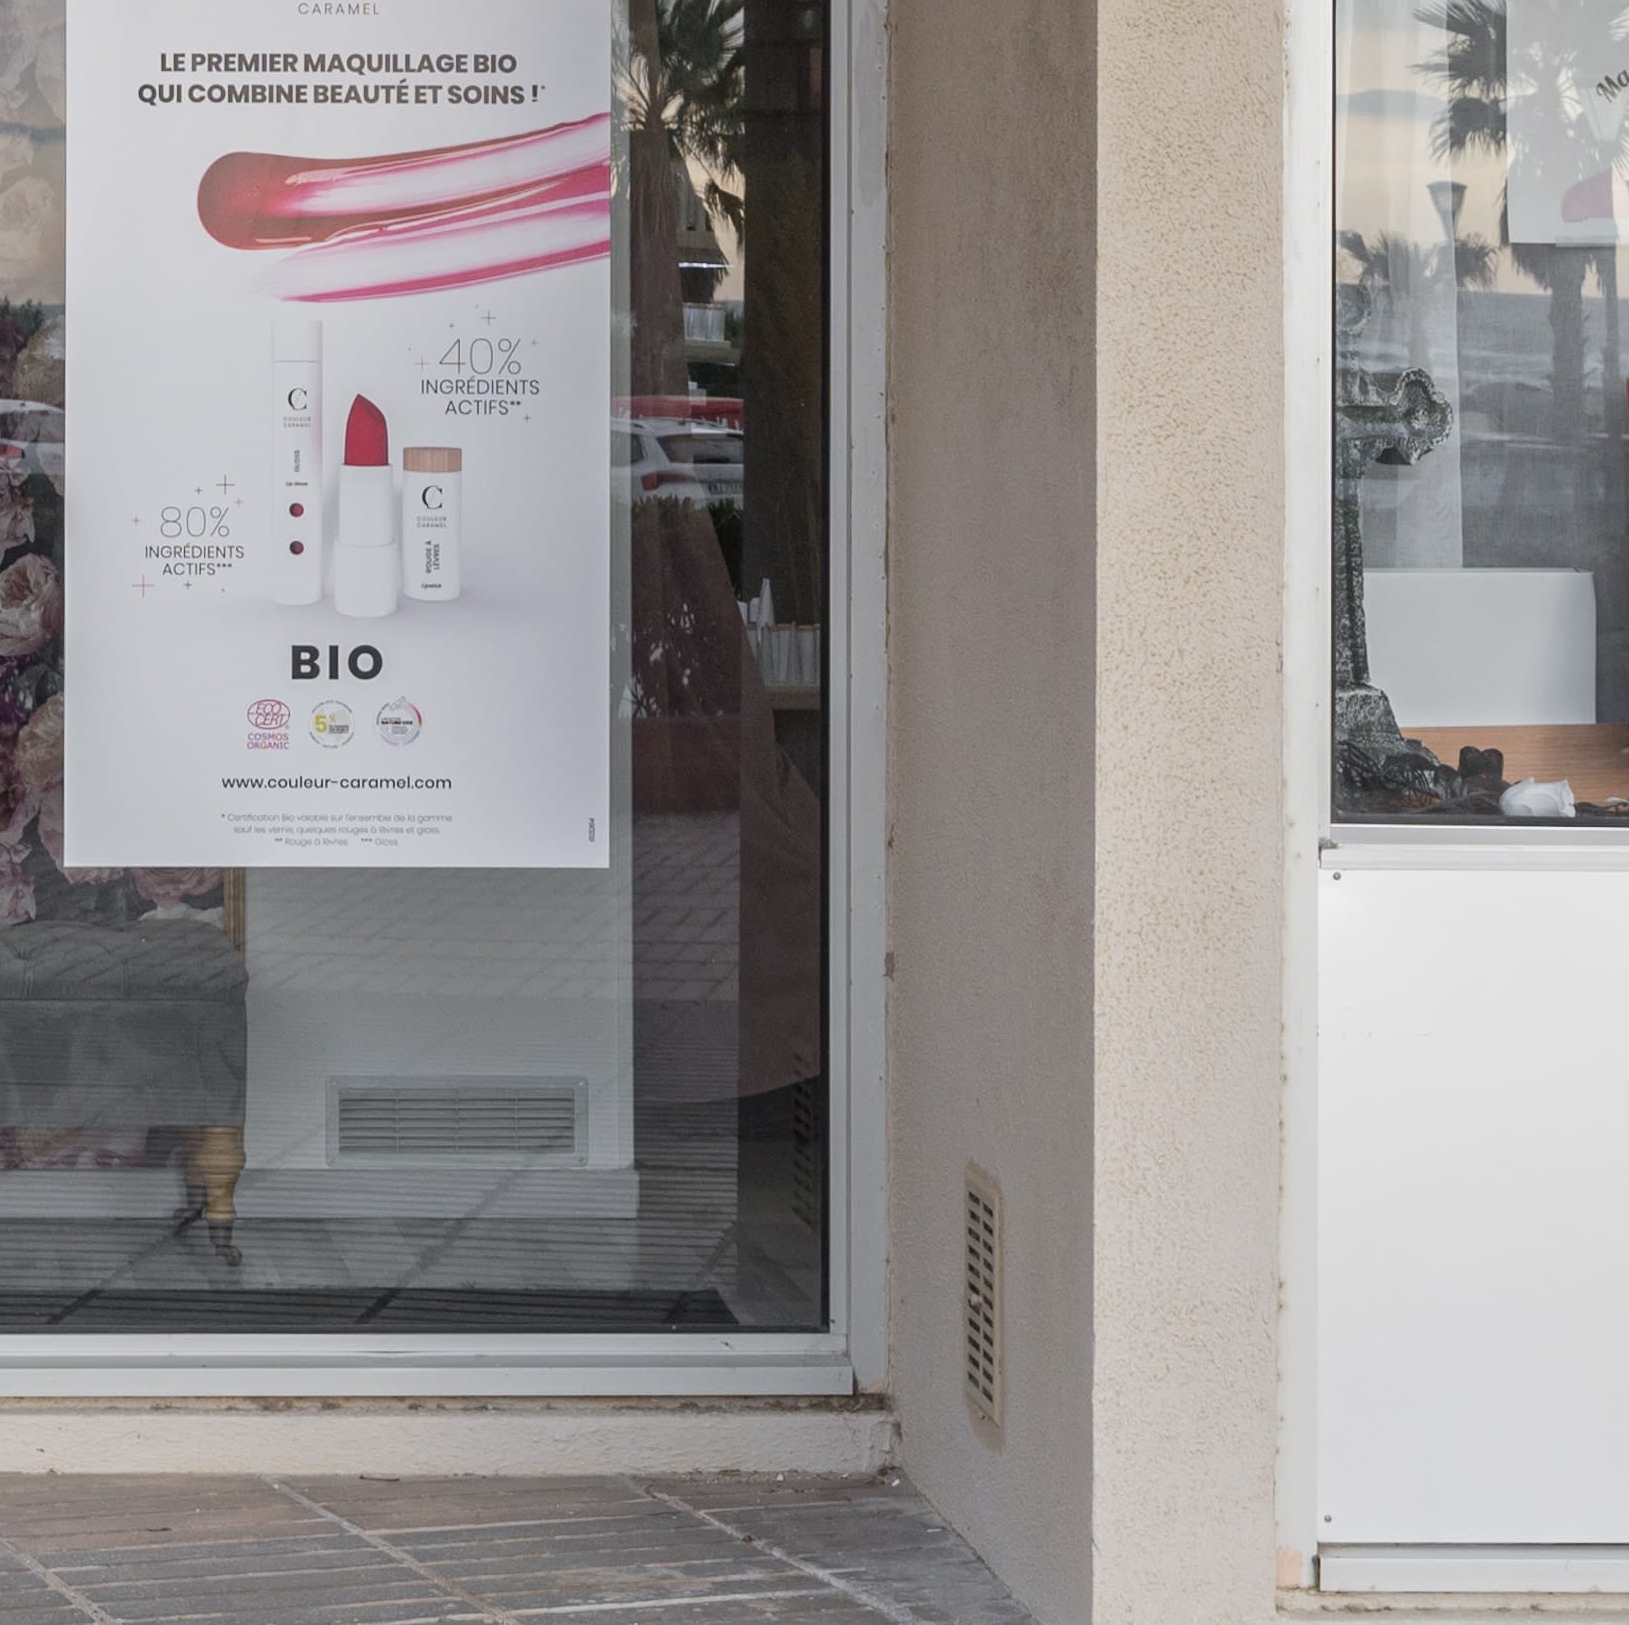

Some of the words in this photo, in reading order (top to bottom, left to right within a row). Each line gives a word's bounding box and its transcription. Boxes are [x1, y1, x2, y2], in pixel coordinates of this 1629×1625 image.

[297, 2, 380, 16] CARAMEL
[160, 53, 186, 73] LE
[191, 53, 298, 73] PREMIER
[303, 53, 469, 75] MAQUILLAGE
[473, 53, 518, 74] BIO
[137, 83, 183, 106] QUI
[187, 83, 309, 105] COMBINE
[313, 78, 409, 105] BEAUTÉ
[414, 85, 442, 105] ET
[447, 84, 526, 105] SOINS
[438, 337, 523, 376] 40%
[421, 375, 541, 396] INGRÉDIENTS
[159, 505, 231, 538] 80%
[144, 541, 245, 560] INGRÉDIENTS
[291, 643, 384, 680] BIO
[255, 702, 283, 715] ECO
[254, 713, 286, 726] CERT
[246, 740, 290, 750] ORGANIC
[247, 732, 290, 741] COSMOS
[221, 775, 453, 790] www.couleur-caramel.com
